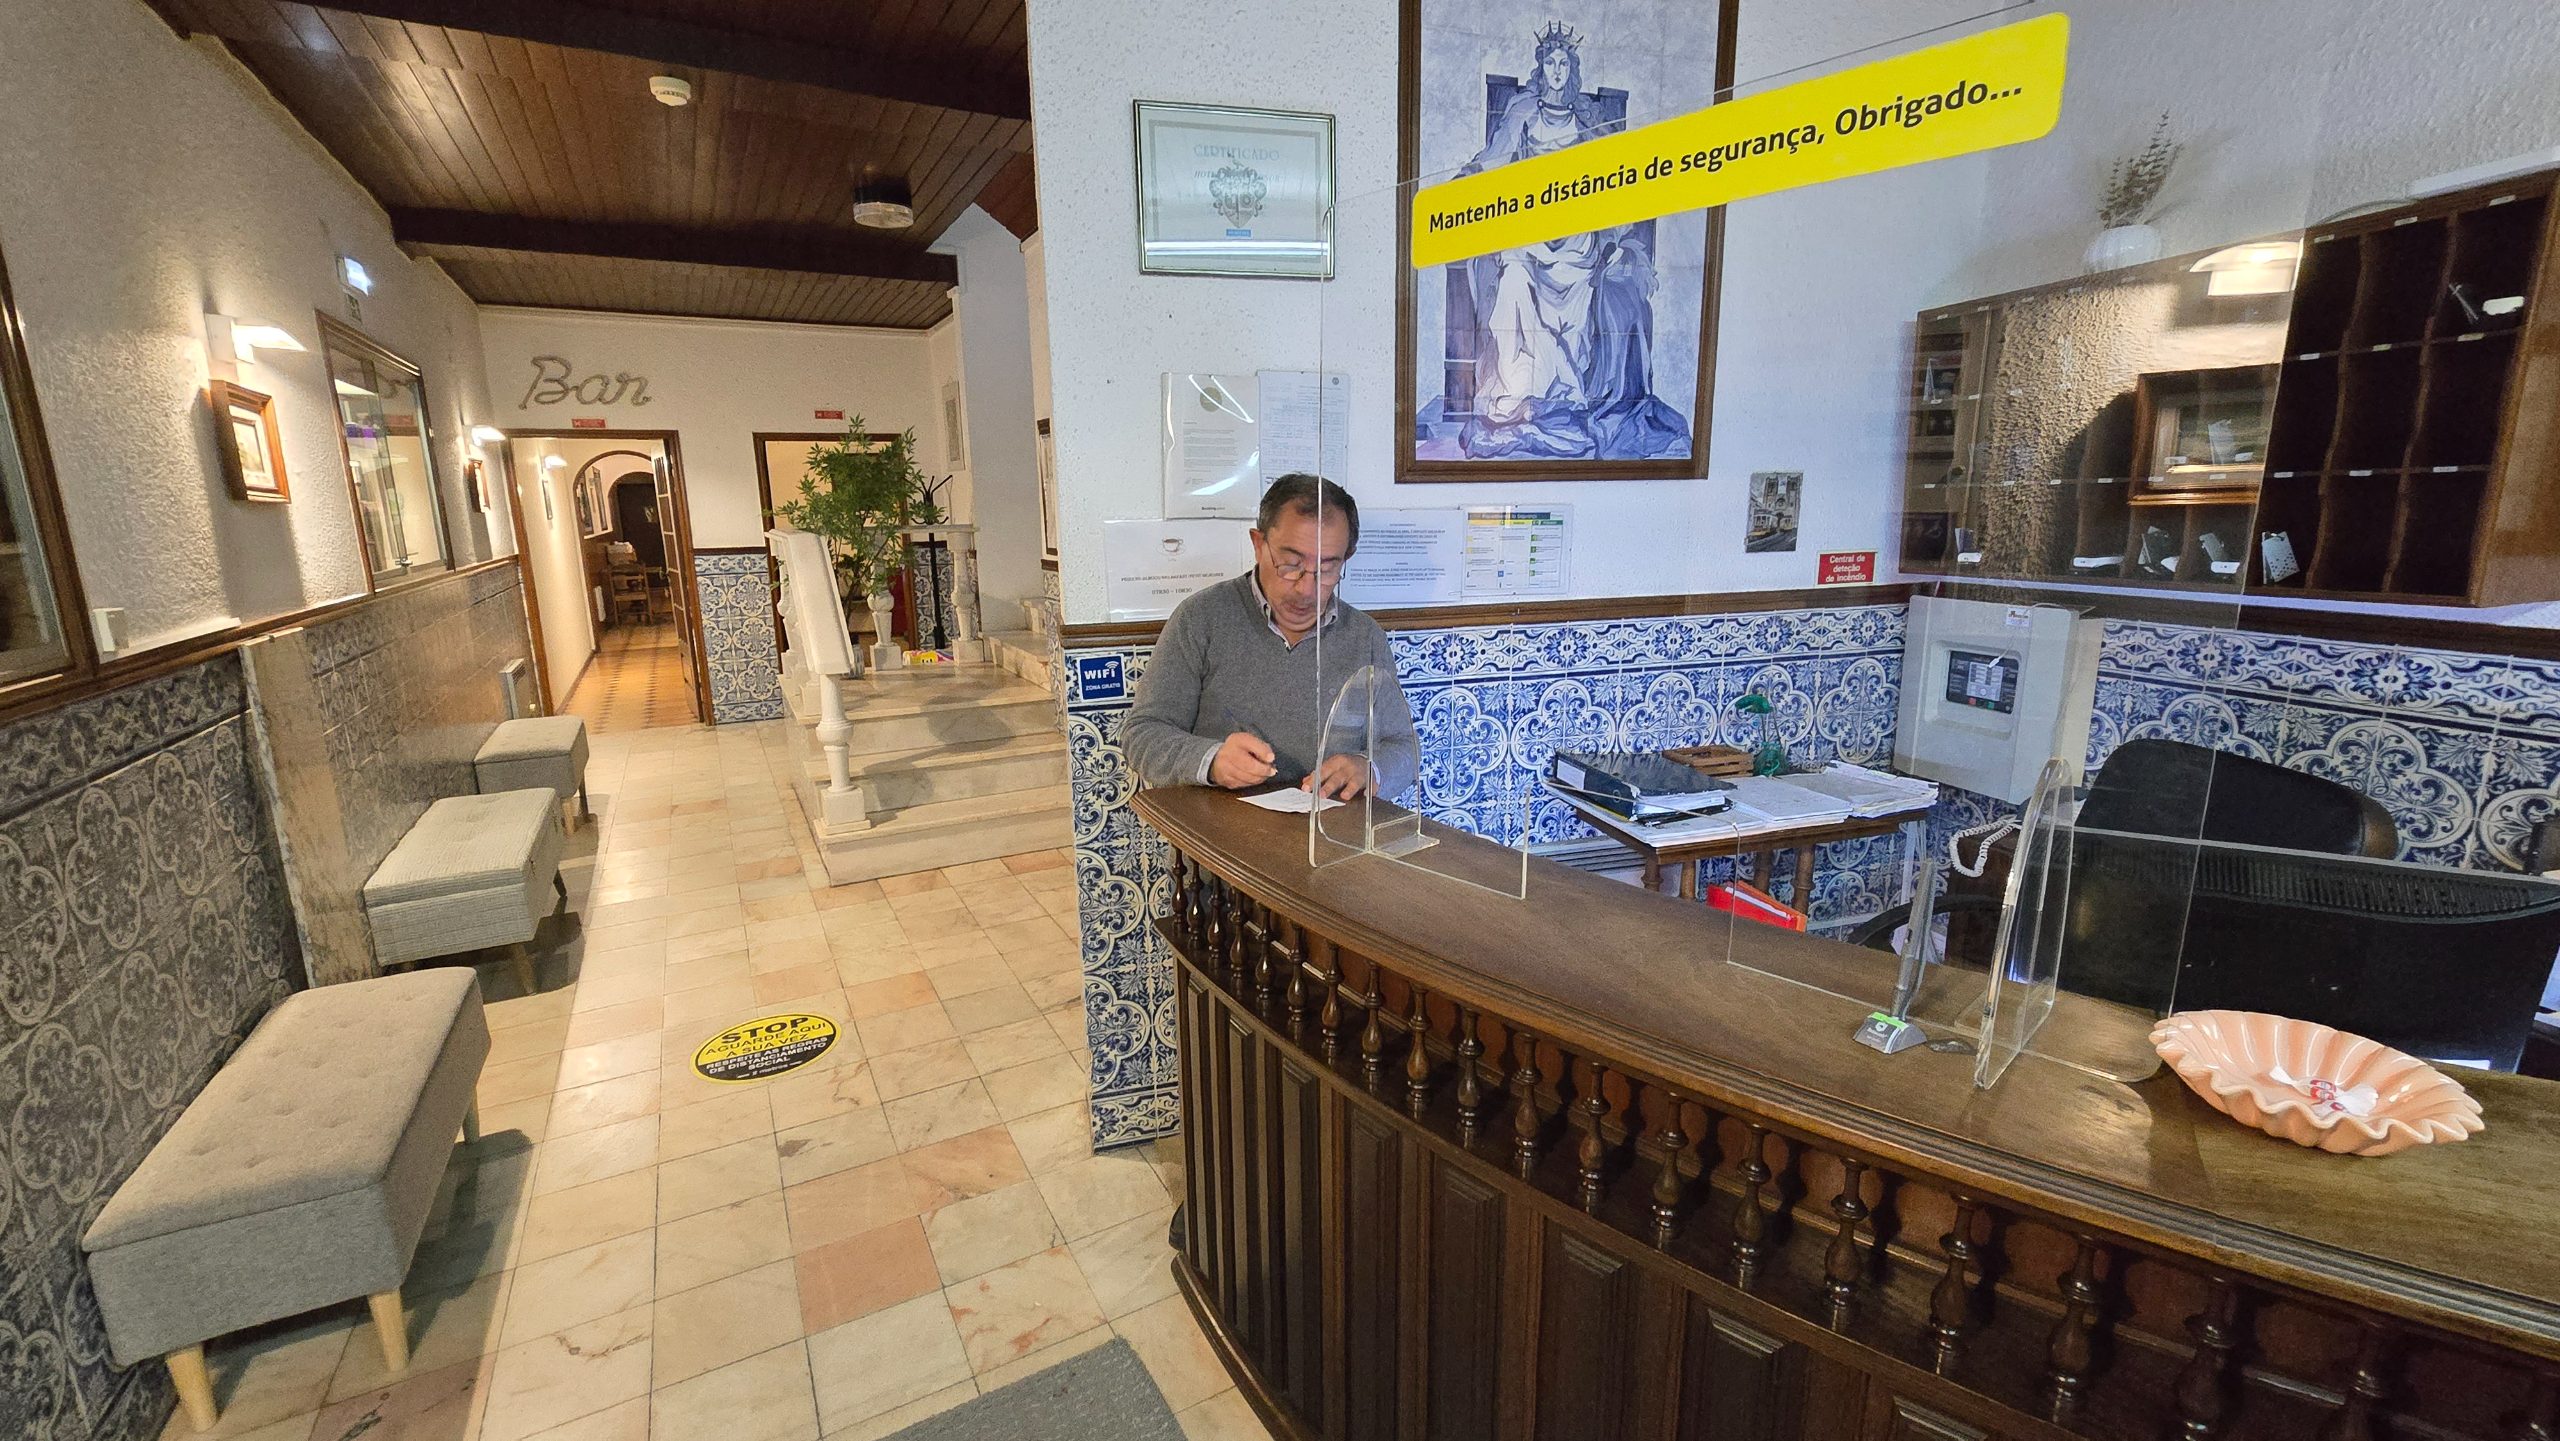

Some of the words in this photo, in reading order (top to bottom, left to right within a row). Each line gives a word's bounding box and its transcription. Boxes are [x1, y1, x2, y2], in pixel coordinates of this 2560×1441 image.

[1194, 144, 1279, 161] CERTIFICADO
[1429, 195, 1519, 233] Mantenha
[1524, 193, 1535, 210] a
[1540, 164, 1637, 206] distância
[1644, 156, 1673, 180] de
[1680, 123, 1825, 173] segurança,
[1834, 80, 2022, 136] Obrigado...
[519, 356, 651, 410] Bar
[1829, 554, 1854, 564] Central
[1856, 554, 1865, 562] de
[1825, 575, 1835, 583] de
[1837, 572, 1866, 582] incêndio
[705, 1031, 784, 1056] AGUARDE
[788, 1022, 826, 1035] AQUI
[721, 1017, 809, 1044] STOP
[706, 1051, 762, 1069] RESPEITE
[763, 1047, 780, 1057] AS
[781, 1036, 828, 1051] REGRAS
[709, 1066, 726, 1075] DE
[728, 1042, 827, 1070] DISTANCIAMENTO
[726, 1050, 738, 1058] A
[742, 1041, 775, 1054] SUA
[779, 1033, 809, 1044] VEZ
[748, 1056, 791, 1070] SOCIAL
[759, 1063, 788, 1074] metros
